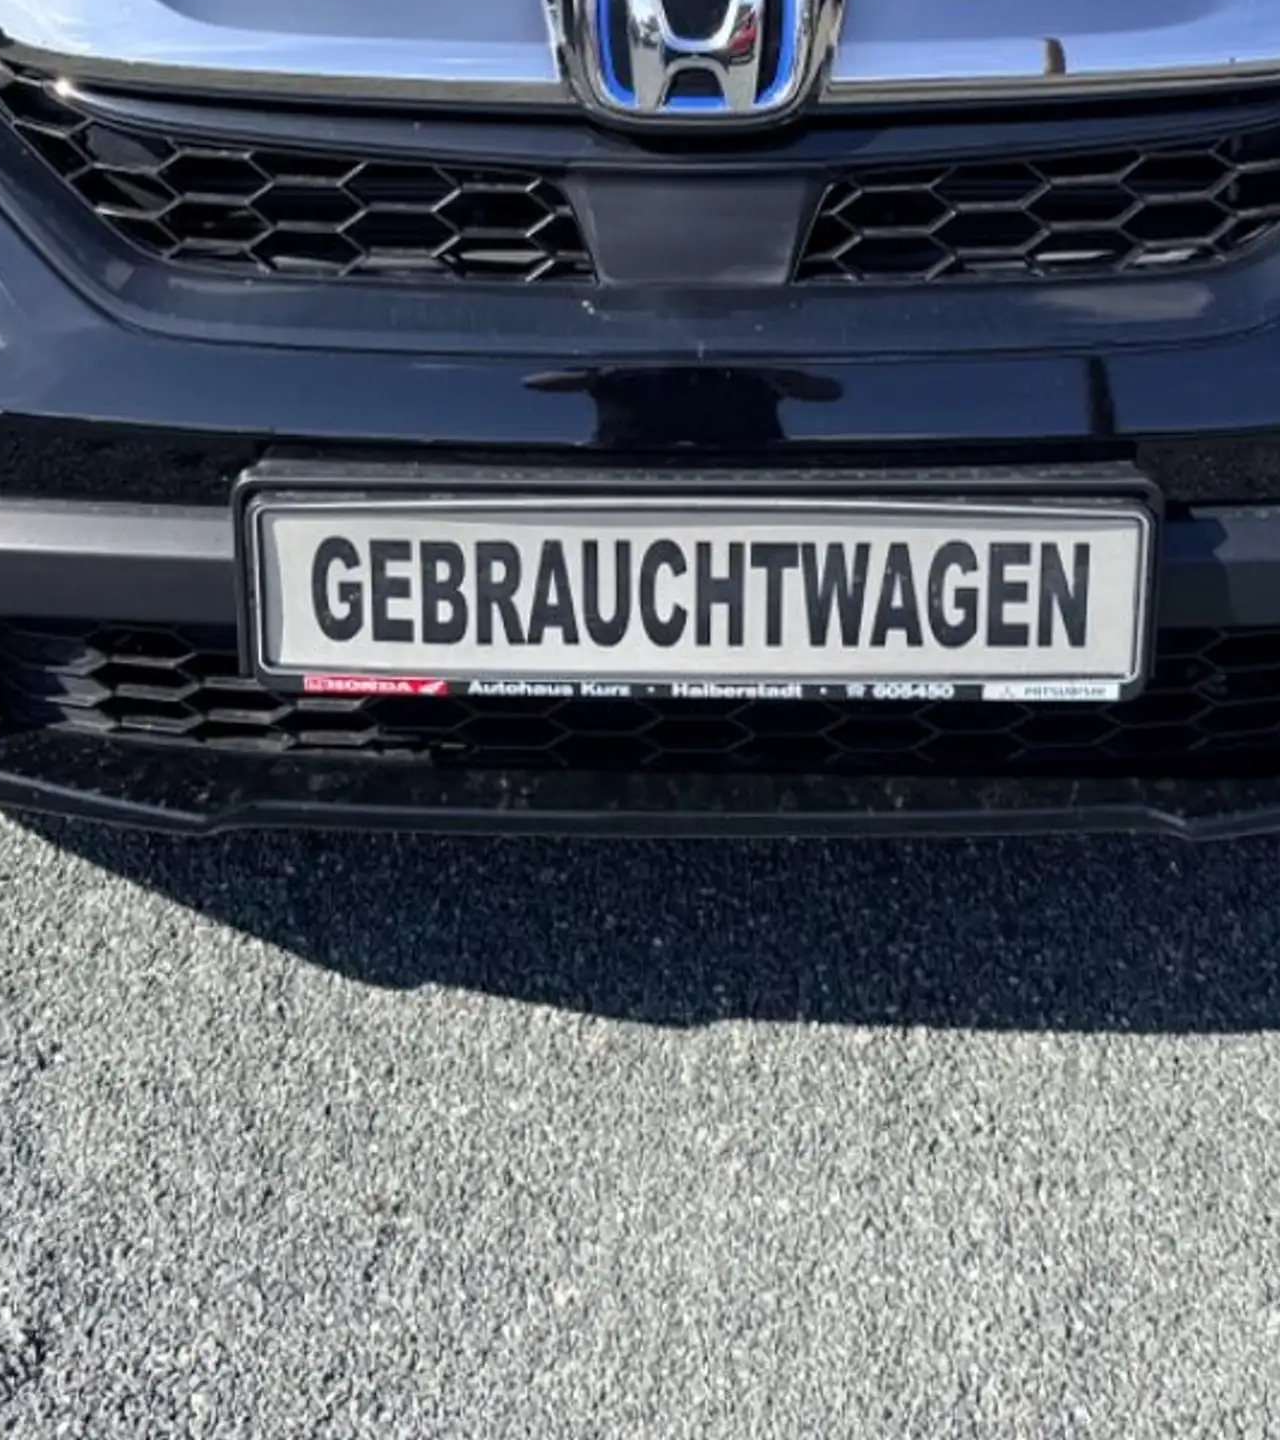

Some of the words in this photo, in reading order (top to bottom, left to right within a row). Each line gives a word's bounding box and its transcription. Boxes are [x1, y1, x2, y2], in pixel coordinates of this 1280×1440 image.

[311, 535, 1090, 648] GEBRAUCHTWAGEN
[323, 678, 412, 694] HONDA
[468, 680, 574, 697] Autohaus
[671, 682, 802, 699] Halberstadt
